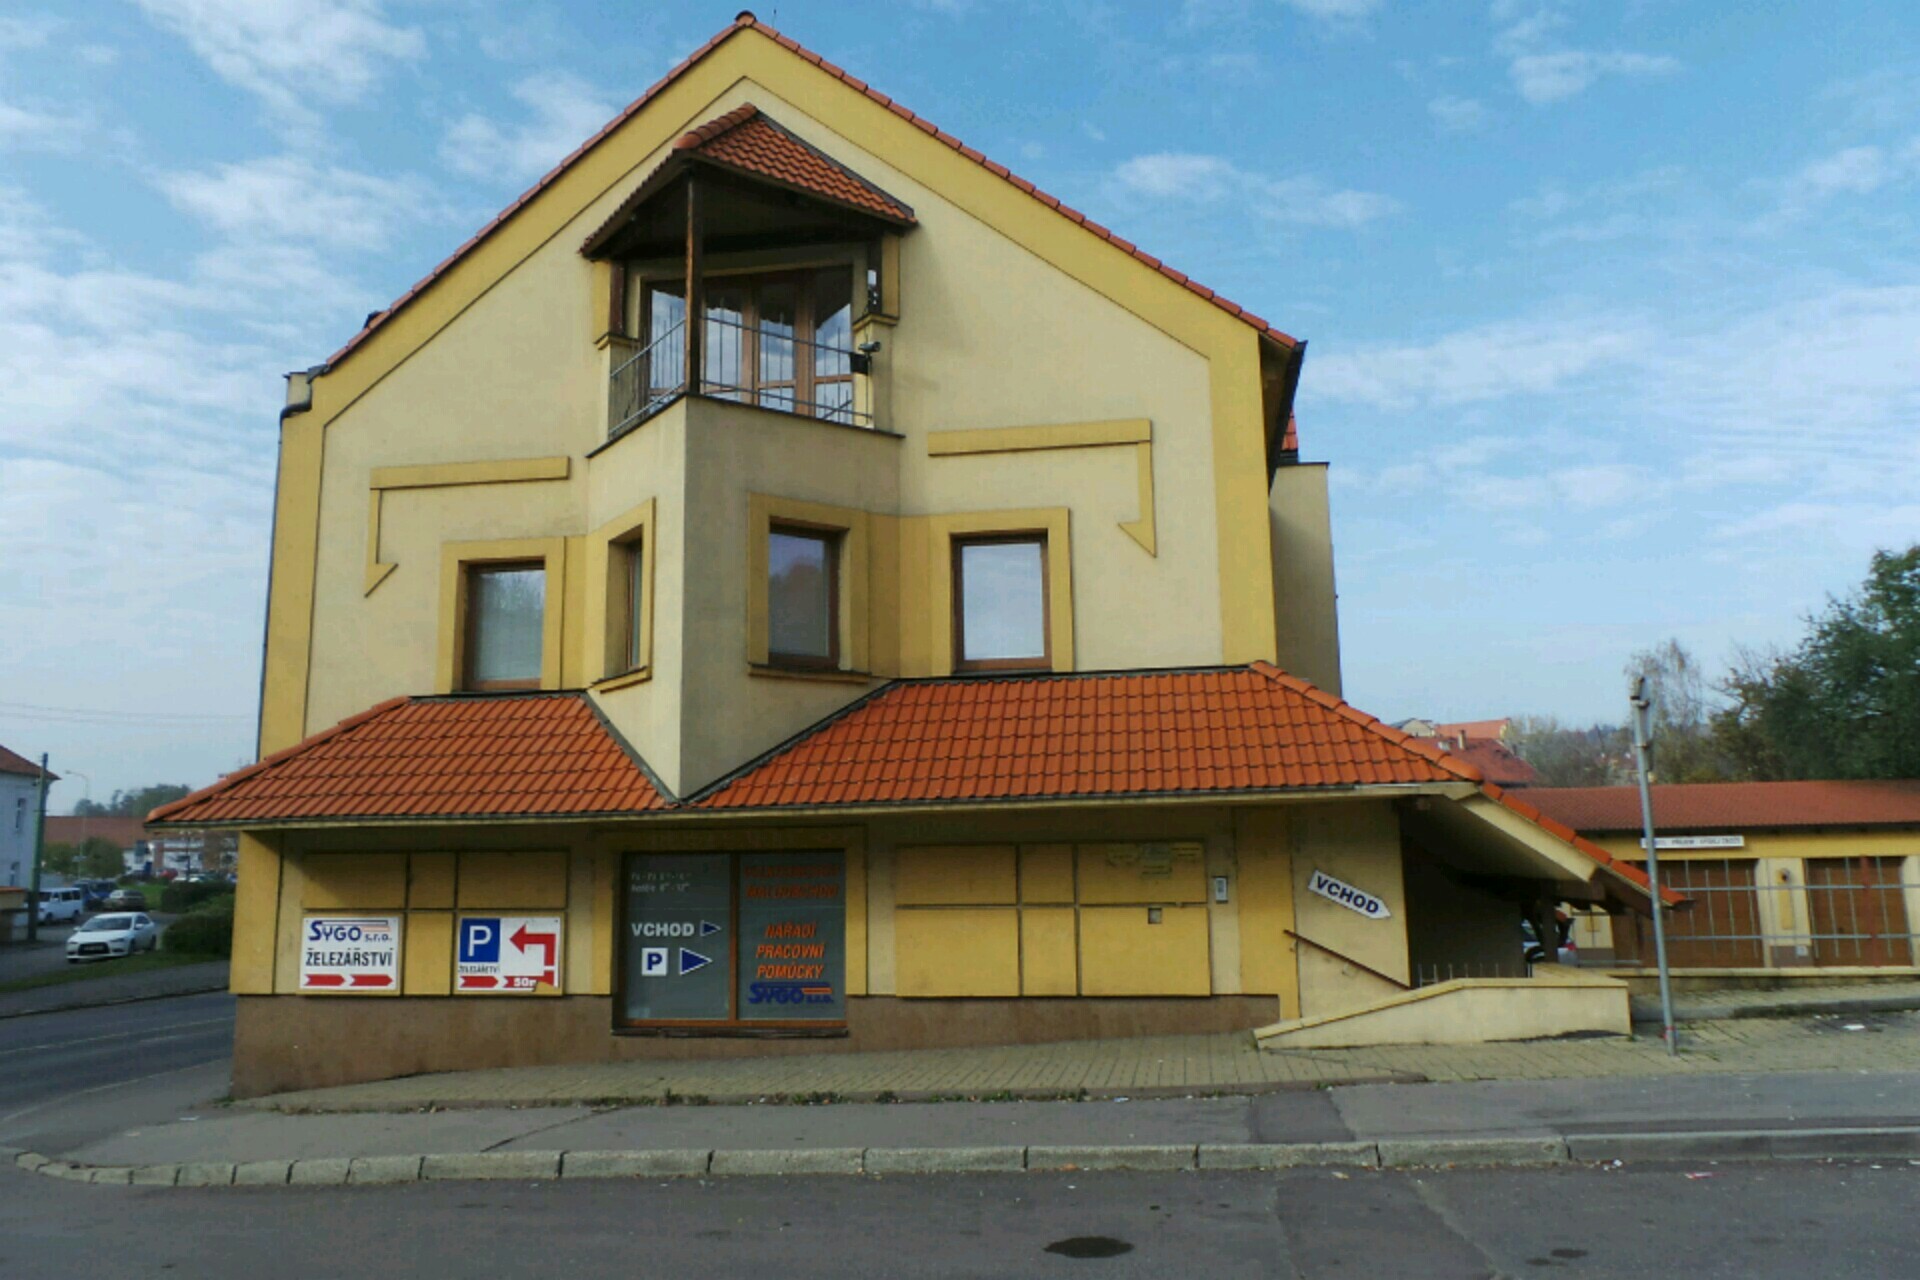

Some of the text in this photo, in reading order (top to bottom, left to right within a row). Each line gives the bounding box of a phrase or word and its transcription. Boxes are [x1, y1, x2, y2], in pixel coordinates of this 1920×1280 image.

[1315, 874, 1379, 914] VCHOD
[308, 920, 361, 942] SYGO
[631, 923, 695, 937] VCHOD
[468, 925, 491, 957] P
[755, 942, 824, 958] PRACOVNÍ
[305, 947, 394, 967] ŽELEZÁŘSTVÍ
[646, 953, 662, 970] P
